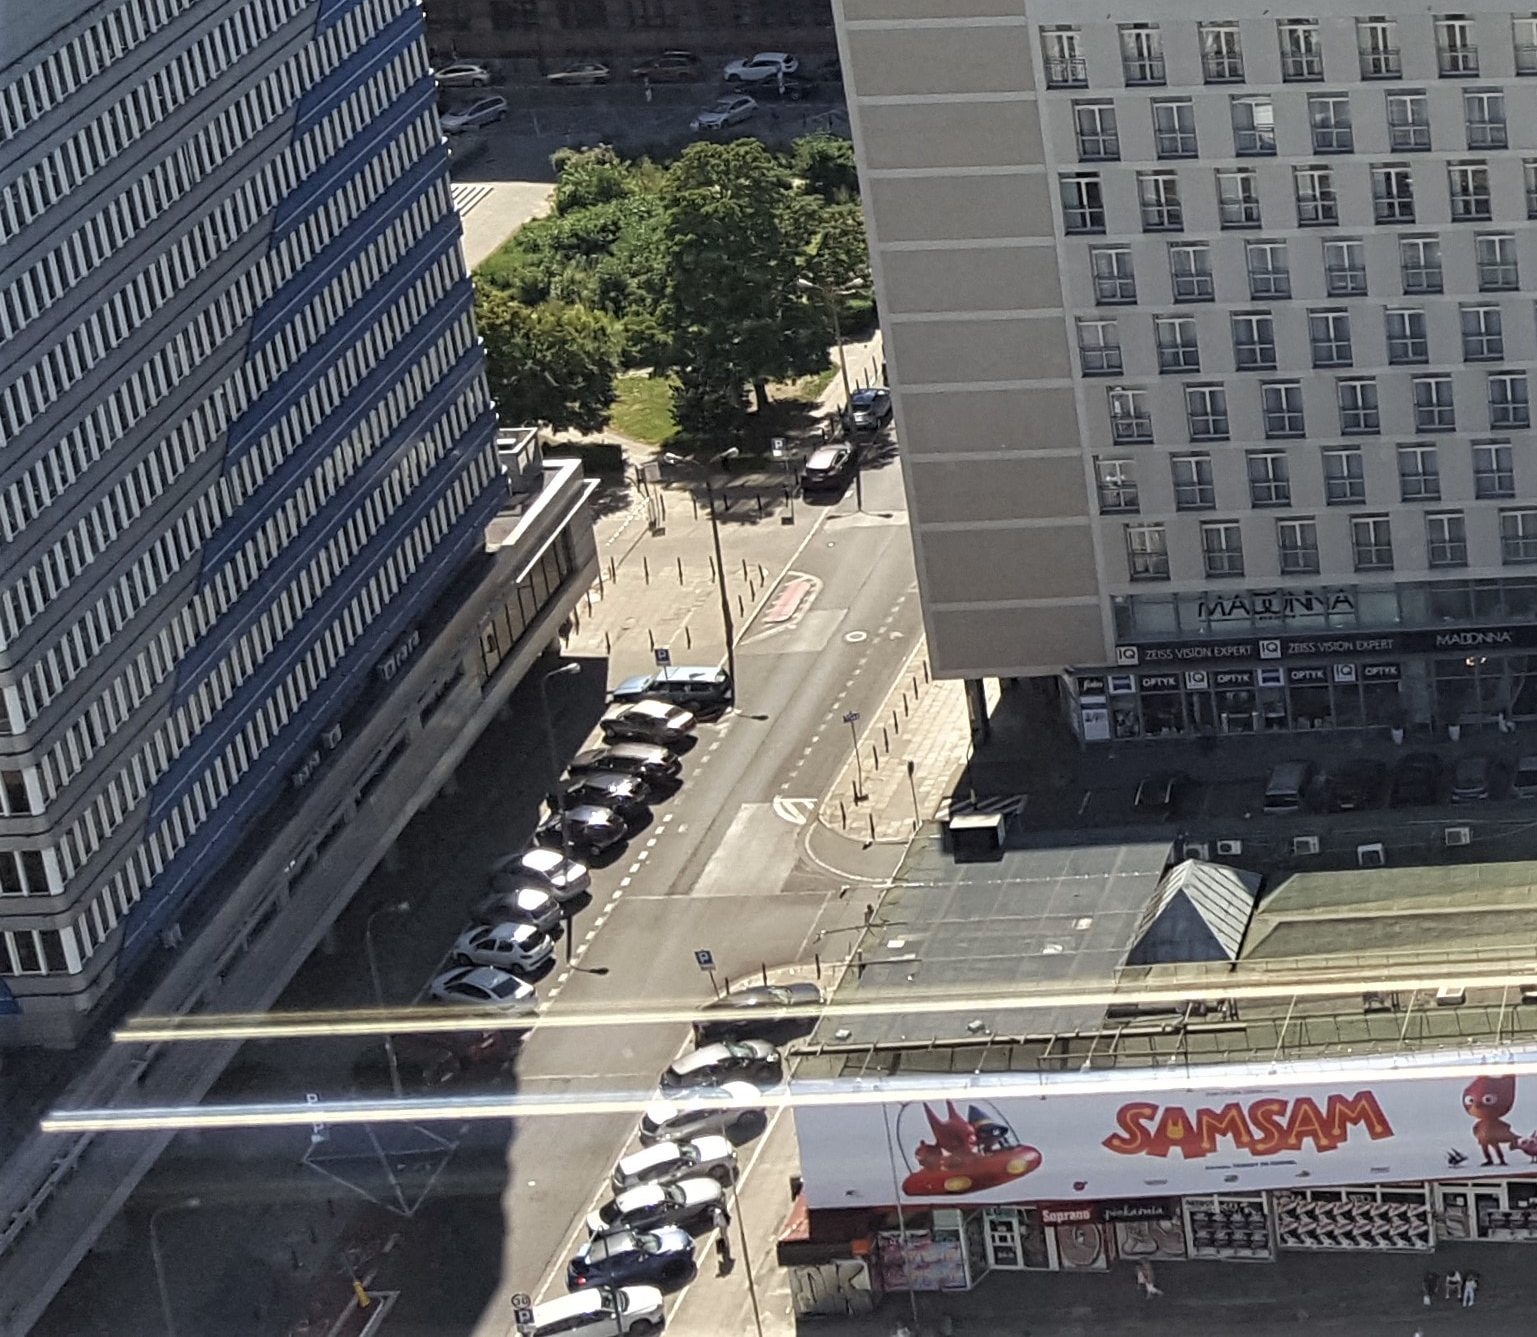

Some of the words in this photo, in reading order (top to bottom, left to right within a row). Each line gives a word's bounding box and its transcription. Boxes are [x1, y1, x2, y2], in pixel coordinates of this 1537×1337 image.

[1198, 590, 1354, 616] MADONNA
[1436, 631, 1512, 646] MADONNA
[1145, 649, 1173, 660] ZEISS
[1175, 647, 1212, 659] VISION
[1214, 646, 1252, 657] EXPERT
[1261, 641, 1279, 654] IQ
[1288, 642, 1315, 654] ZEISS
[1317, 641, 1353, 653] VISION
[1356, 639, 1394, 651] EXPERT
[1291, 669, 1325, 681] OPTYK
[1335, 664, 1353, 676] IQ
[1364, 666, 1398, 677] OPTYK
[1142, 676, 1175, 688] OPTYK
[1186, 672, 1205, 684] IQ
[1216, 673, 1250, 684] OPTYK
[1101, 1090, 1395, 1160] SAMSAM
[1042, 1209, 1091, 1223] Soprano
